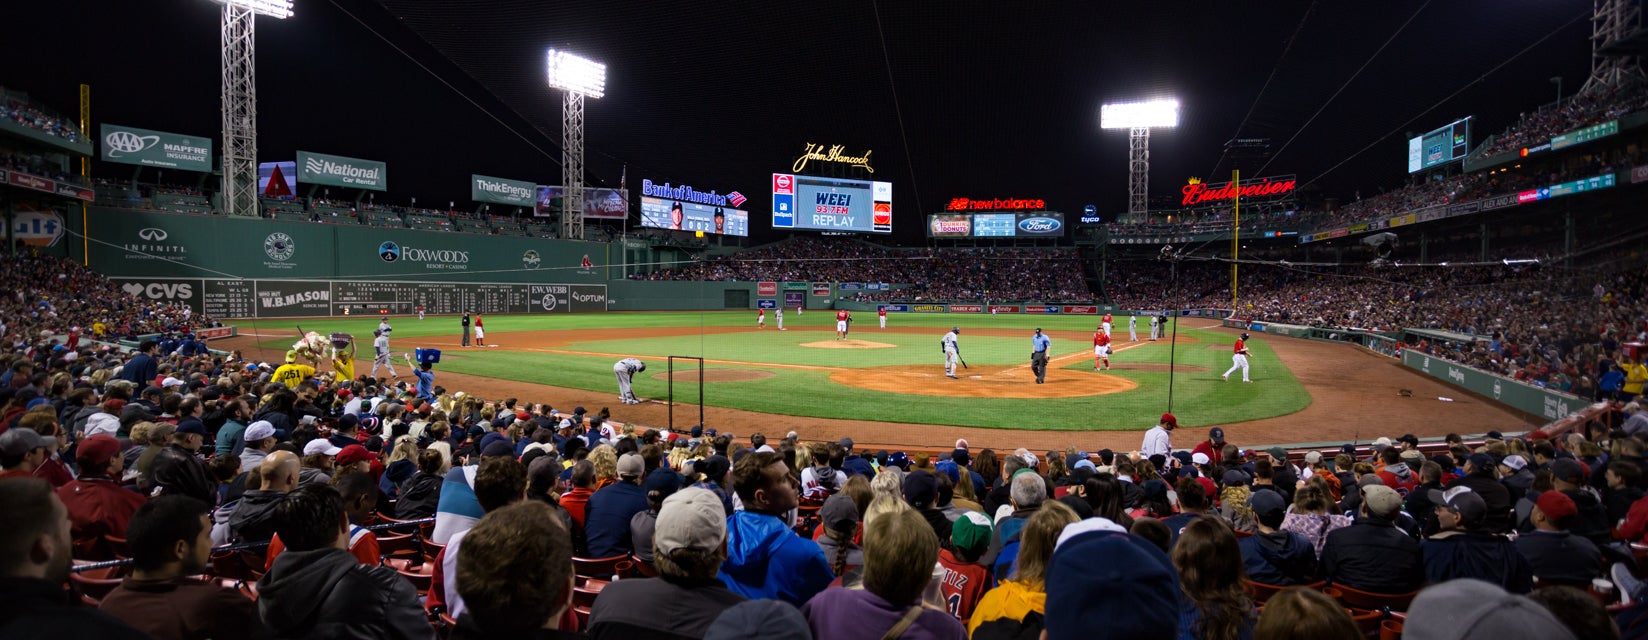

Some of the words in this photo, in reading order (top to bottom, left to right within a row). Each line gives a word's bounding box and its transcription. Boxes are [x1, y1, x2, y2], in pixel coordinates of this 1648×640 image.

[110, 132, 141, 152] AAA
[164, 143, 208, 154] MAPFRE
[166, 152, 206, 162] INSURANCE
[793, 142, 826, 173] John
[824, 143, 875, 173] Hancock
[323, 161, 378, 179] National
[477, 179, 532, 199] ThinkEnergy
[643, 179, 673, 198] Bank
[673, 184, 685, 200] of
[685, 186, 726, 206] America
[1182, 177, 1296, 206] Budweiser
[816, 192, 852, 206] WEEI
[1483, 199, 1496, 209] ALEX
[1496, 197, 1510, 207] AND
[689, 221, 693, 229] 0
[704, 222, 709, 230] 2
[813, 214, 855, 227] REPLAY
[1026, 219, 1053, 231] Ford
[1081, 216, 1100, 224] tyco
[124, 243, 184, 253] INFINITI
[402, 246, 469, 263] FOXWOODS
[145, 282, 193, 299] CVS
[545, 286, 567, 294] WEBB
[580, 294, 605, 303] OPTUM
[284, 369, 300, 380] 251
[943, 567, 969, 590] TIZ
